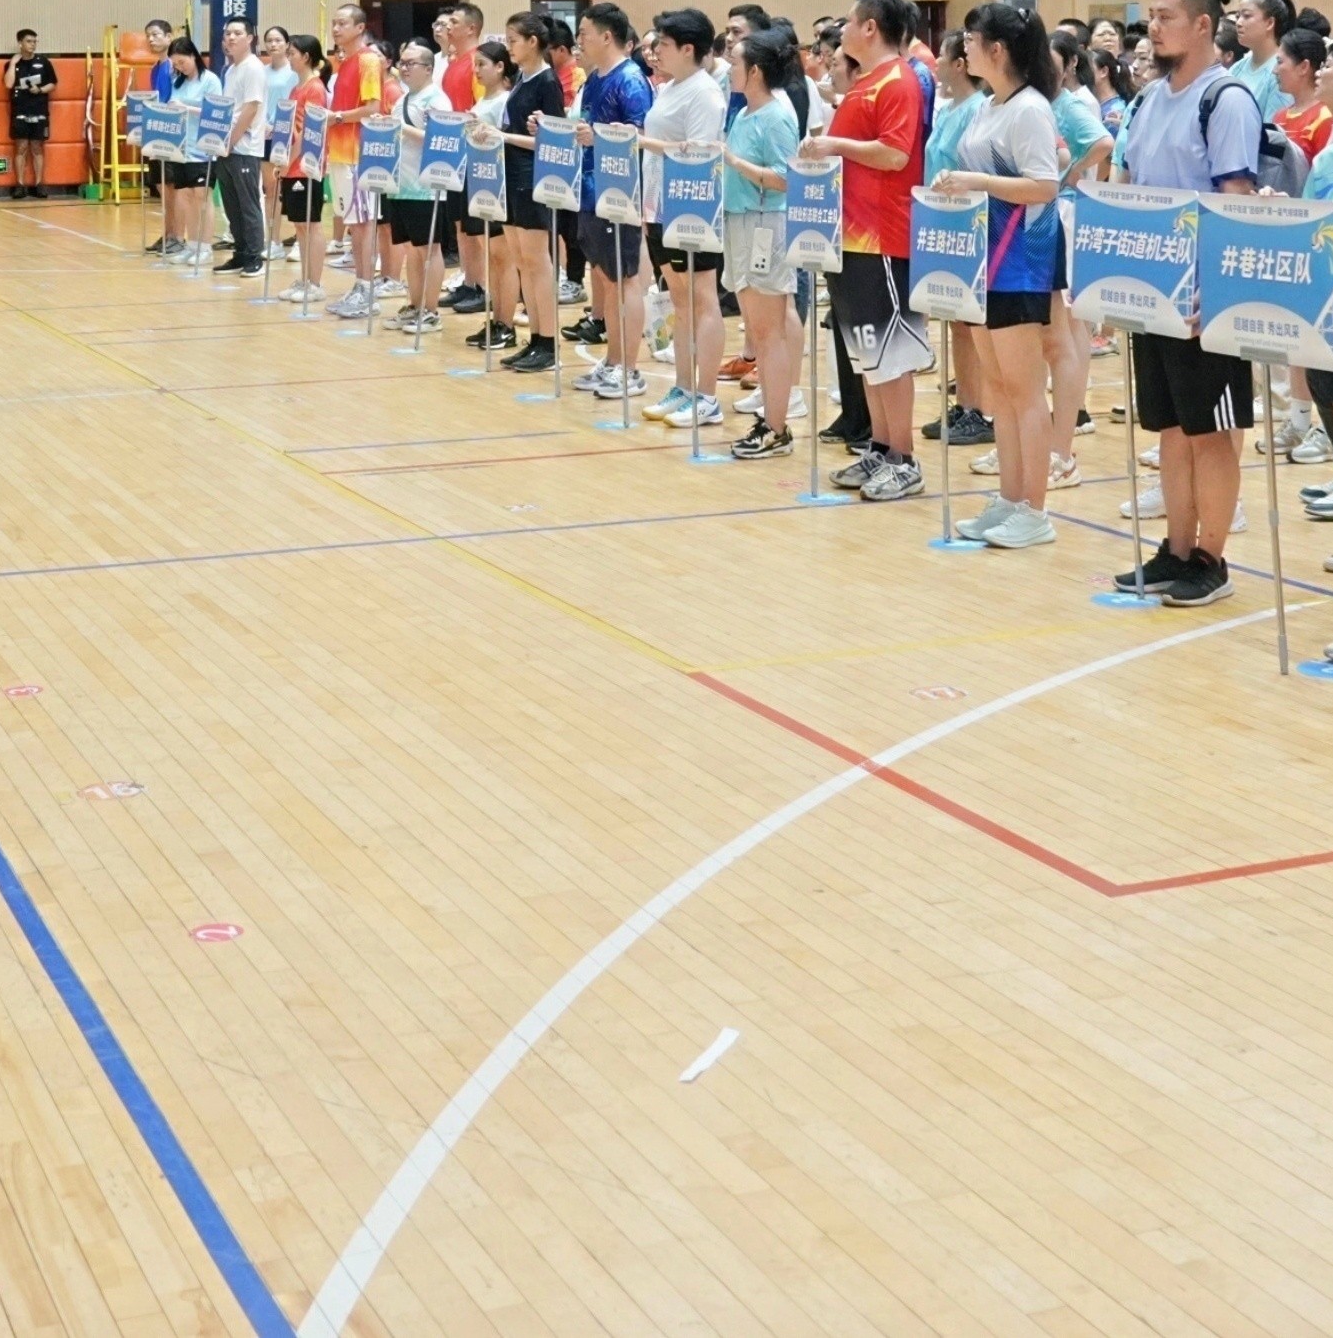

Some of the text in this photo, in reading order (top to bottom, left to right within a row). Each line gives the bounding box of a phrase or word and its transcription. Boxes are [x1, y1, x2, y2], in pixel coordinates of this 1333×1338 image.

[668, 178, 715, 202] 井湾子社区队
[916, 227, 976, 258] 井圭路社区队
[1075, 223, 1191, 264] 井湾子街道机关队
[1221, 245, 1312, 285] 井巷社区队
[852, 324, 878, 350] 16
[1233, 316, 1300, 339] 超越自我 秀出风采
